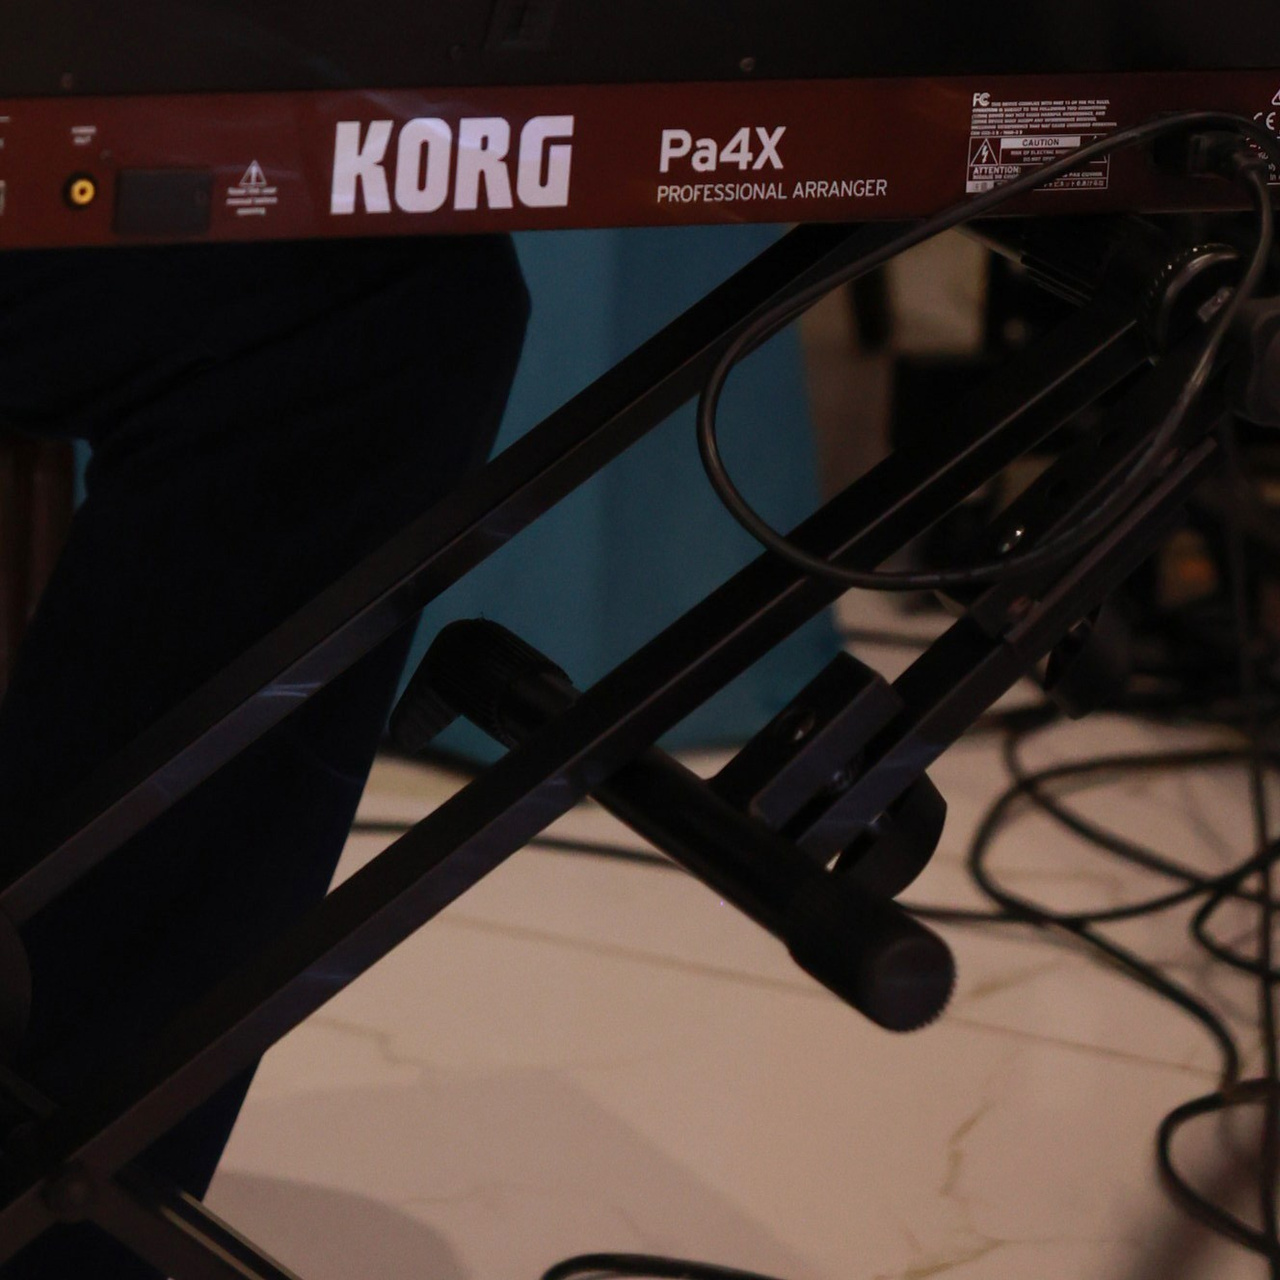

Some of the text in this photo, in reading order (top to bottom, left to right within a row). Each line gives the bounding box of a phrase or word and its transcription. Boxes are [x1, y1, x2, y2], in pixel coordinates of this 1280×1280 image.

[659, 126, 787, 173] Pa4X
[1022, 138, 1059, 146] CAUTION
[330, 115, 574, 214] KORG
[657, 179, 888, 203] PROFESSIONAL ARRANGER
